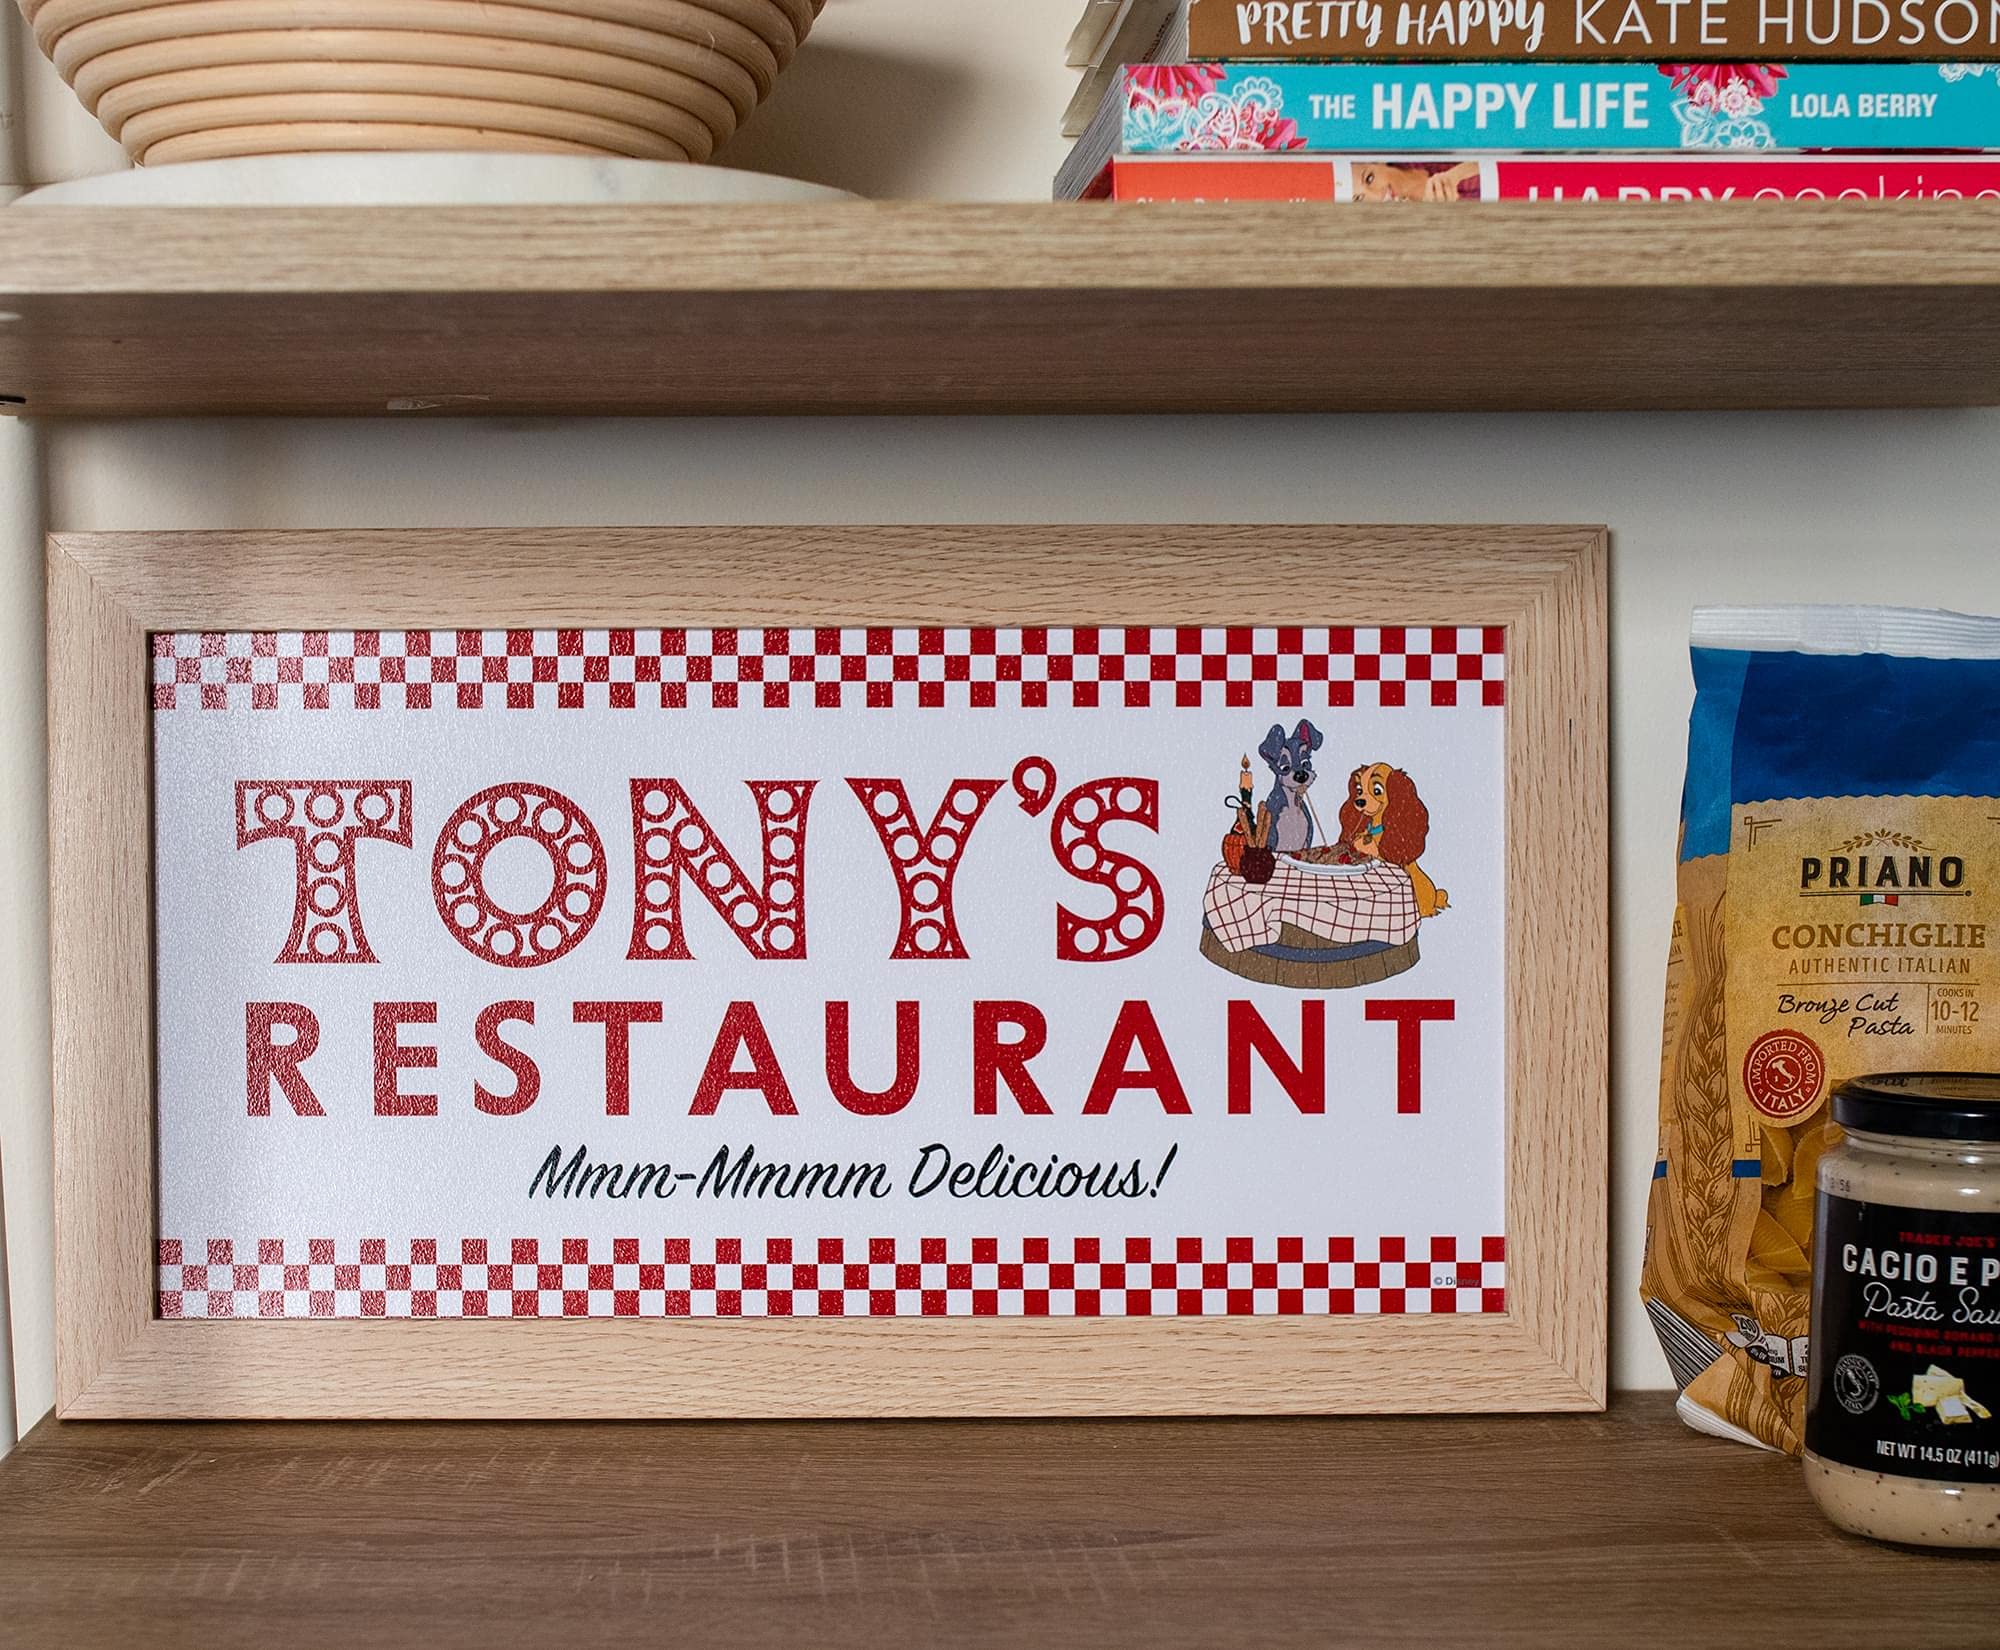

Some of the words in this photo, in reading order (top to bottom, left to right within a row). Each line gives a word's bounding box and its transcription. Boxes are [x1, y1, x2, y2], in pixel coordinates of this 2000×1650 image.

[1236, 0, 1383, 48] PRETTY
[1396, 0, 1546, 53] HAPPY
[1575, 0, 1728, 45] KATE
[1758, 0, 2000, 45] HUDSO
[1308, 94, 1356, 119] THE
[1371, 82, 1538, 130] HAPPY
[1552, 82, 1650, 130] LIFE
[1790, 93, 1851, 118] LOLA
[1857, 93, 1938, 118] BERRY
[234, 755, 1166, 969] TONY'S
[1800, 854, 1965, 890] PRIANO
[1771, 922, 1987, 950] CONCHIGLIE
[1788, 956, 1892, 975] AUTHENTIC
[1897, 957, 1971, 974] ITALIAN
[1776, 993, 1851, 1025] Bronze
[1854, 991, 1900, 1013] Cut
[1936, 987, 1964, 998] COOKS
[1964, 988, 1975, 998] IN
[1847, 1015, 1915, 1038] Pasta
[1930, 1000, 1981, 1023] 10-12
[1935, 1025, 1974, 1035] MINUTES
[245, 999, 1456, 1118] RESTAURANT
[1751, 1040, 1798, 1087] IMPORTED
[1796, 1047, 1817, 1085] FROM
[1762, 1088, 1806, 1111] ITALY
[908, 1142, 1179, 1199] Delicious!
[1842, 1243, 1938, 1284] CACIO
[1949, 1256, 1969, 1286] E
[1863, 1281, 1945, 1322] Pasta
[1876, 1439, 1897, 1457] NET
[1896, 1442, 1918, 1460] WT
[1919, 1445, 1944, 1463] 14.5
[1945, 1448, 1962, 1464] OZ
[1963, 1449, 2000, 1469] (411g)
